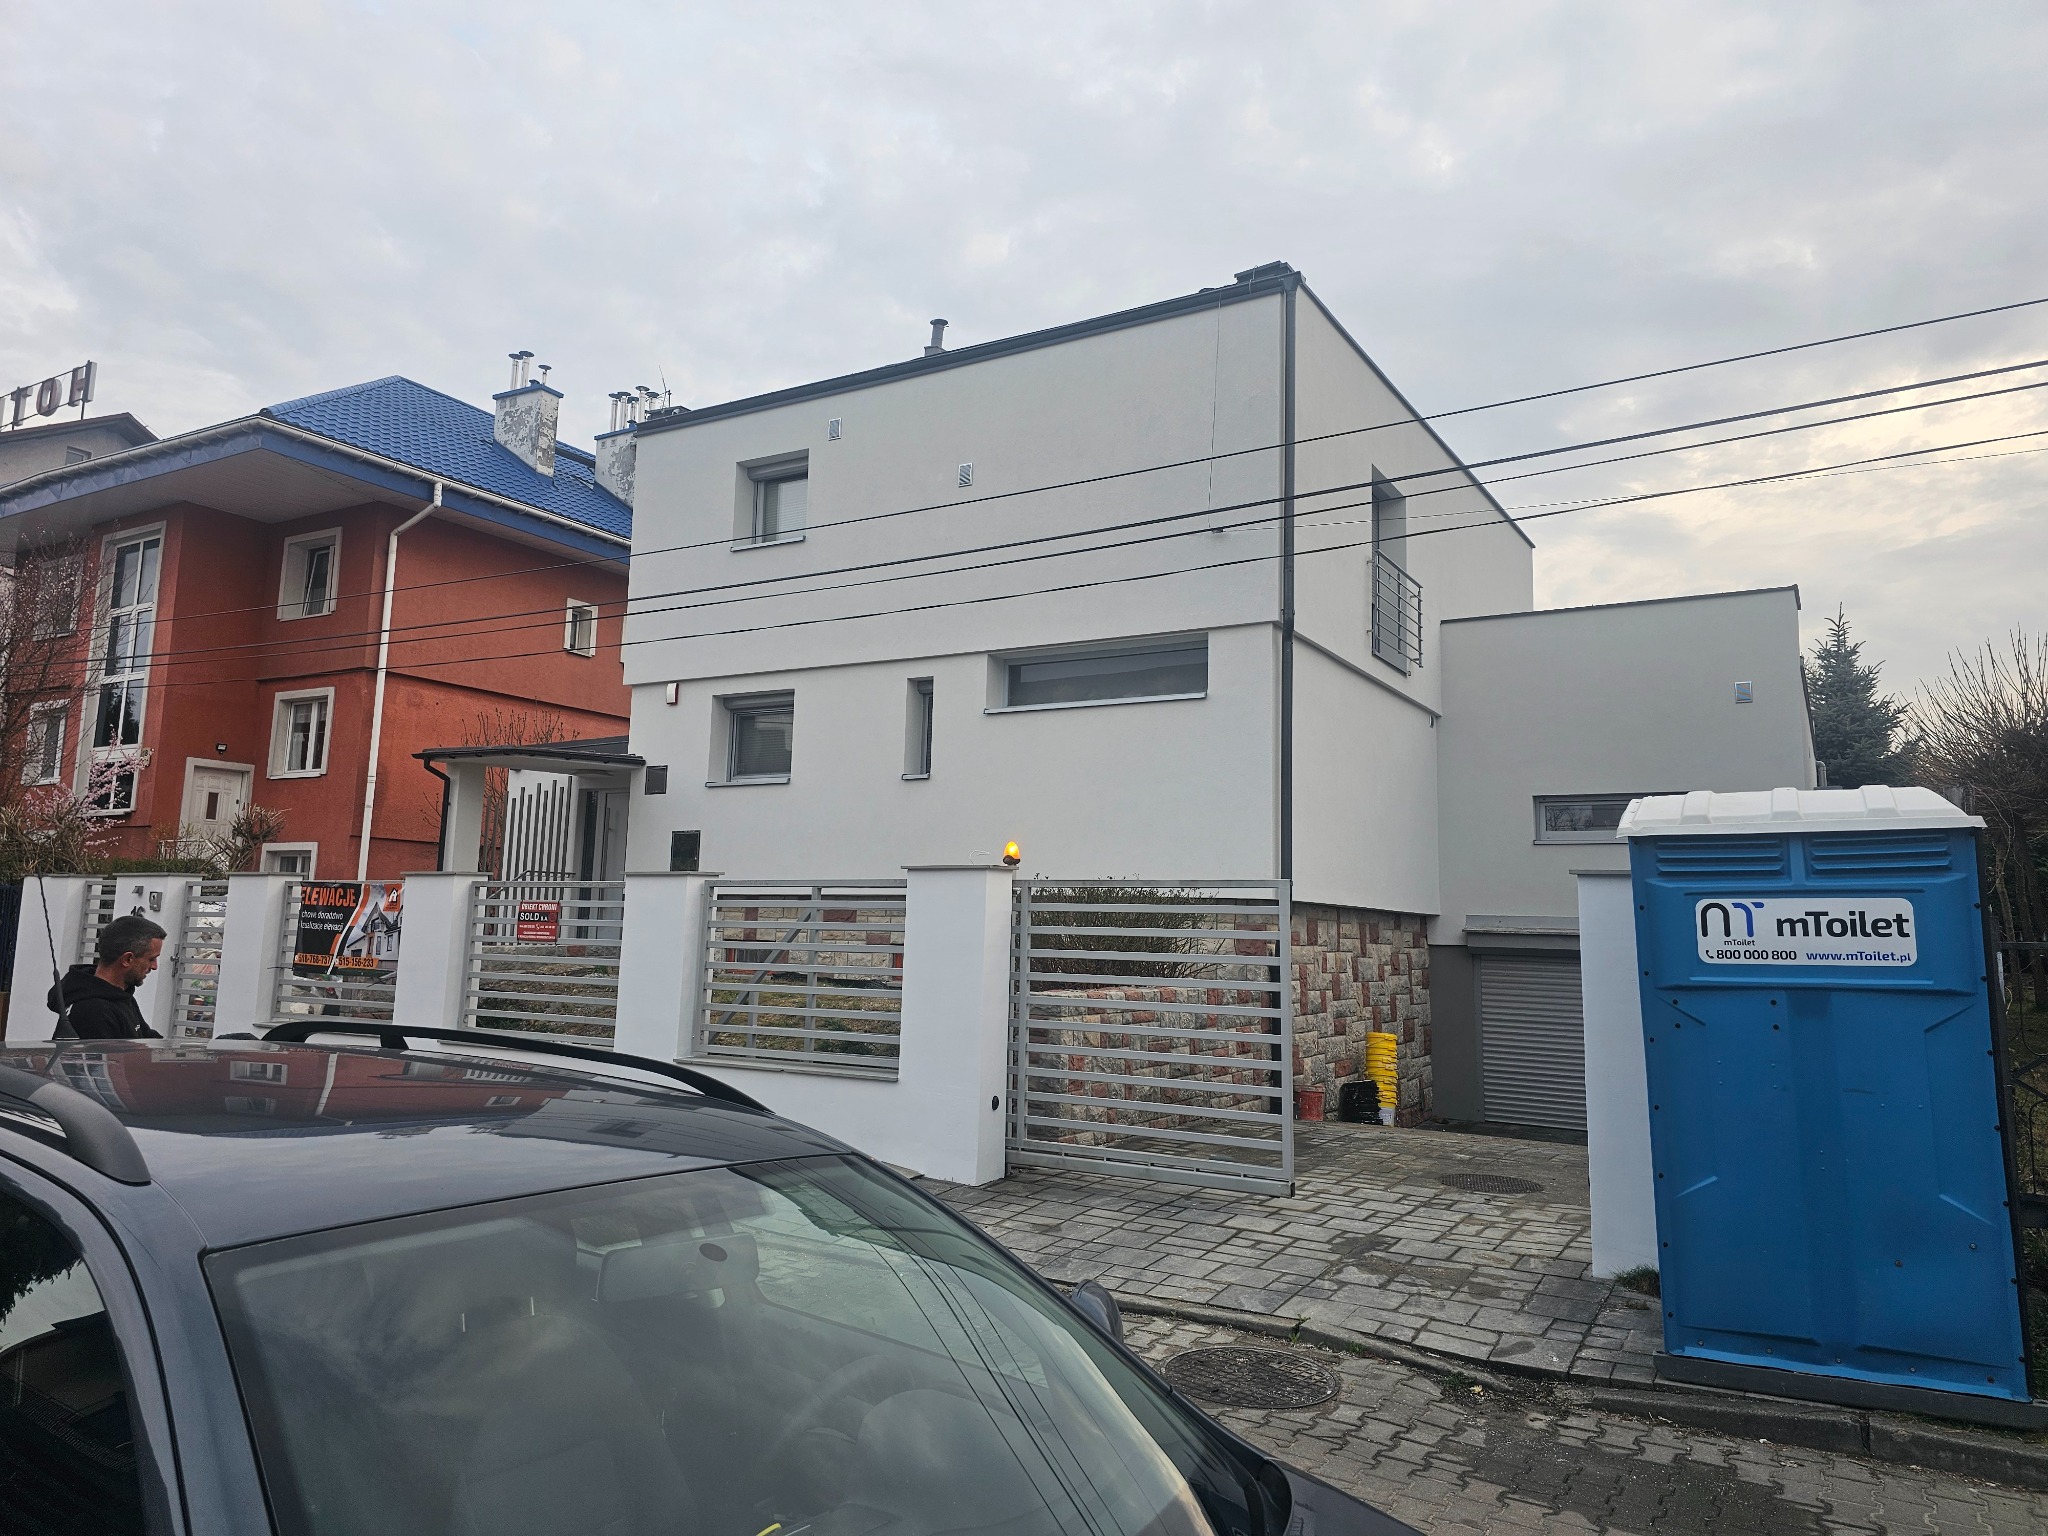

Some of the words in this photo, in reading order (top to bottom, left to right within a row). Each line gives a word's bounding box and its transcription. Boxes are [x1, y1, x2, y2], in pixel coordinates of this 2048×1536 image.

[519, 912, 539, 920] SOLD
[1776, 910, 1911, 938] mToilet
[1723, 938, 1756, 947] mToilet
[1716, 949, 1741, 960] 800
[1743, 949, 1768, 961] 000
[1771, 950, 1797, 961] 800
[1806, 951, 1912, 963] www.mToilet.pl
